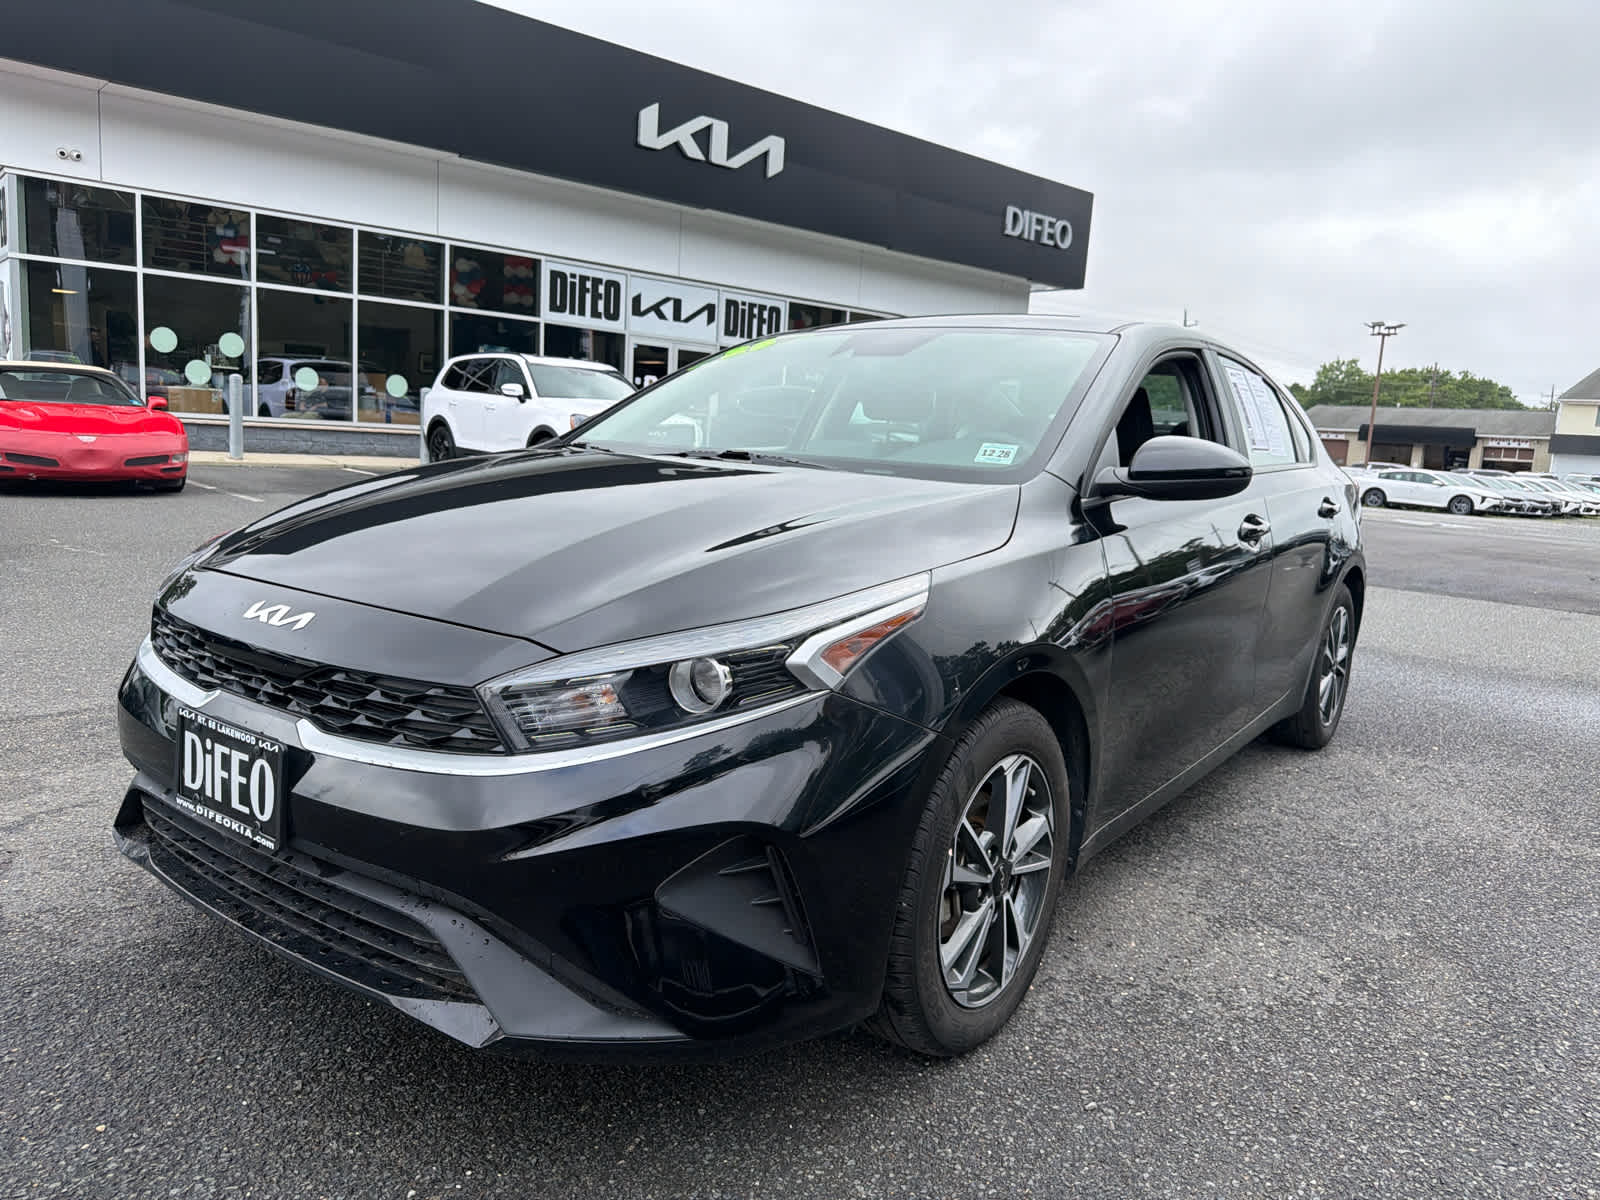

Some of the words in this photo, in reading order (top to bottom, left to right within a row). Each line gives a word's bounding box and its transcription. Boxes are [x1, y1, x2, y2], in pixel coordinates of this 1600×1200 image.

[638, 102, 785, 178] KIA
[1004, 205, 1073, 249] DIFEO
[549, 269, 621, 322] DiFEO
[631, 293, 716, 327] KIA
[723, 298, 782, 339] DiFEO
[243, 600, 316, 631] KIA
[217, 723, 256, 745] LAKEWOOD
[184, 730, 275, 822] DiFEO
[176, 797, 275, 850] www.DIFEOKIA.com
